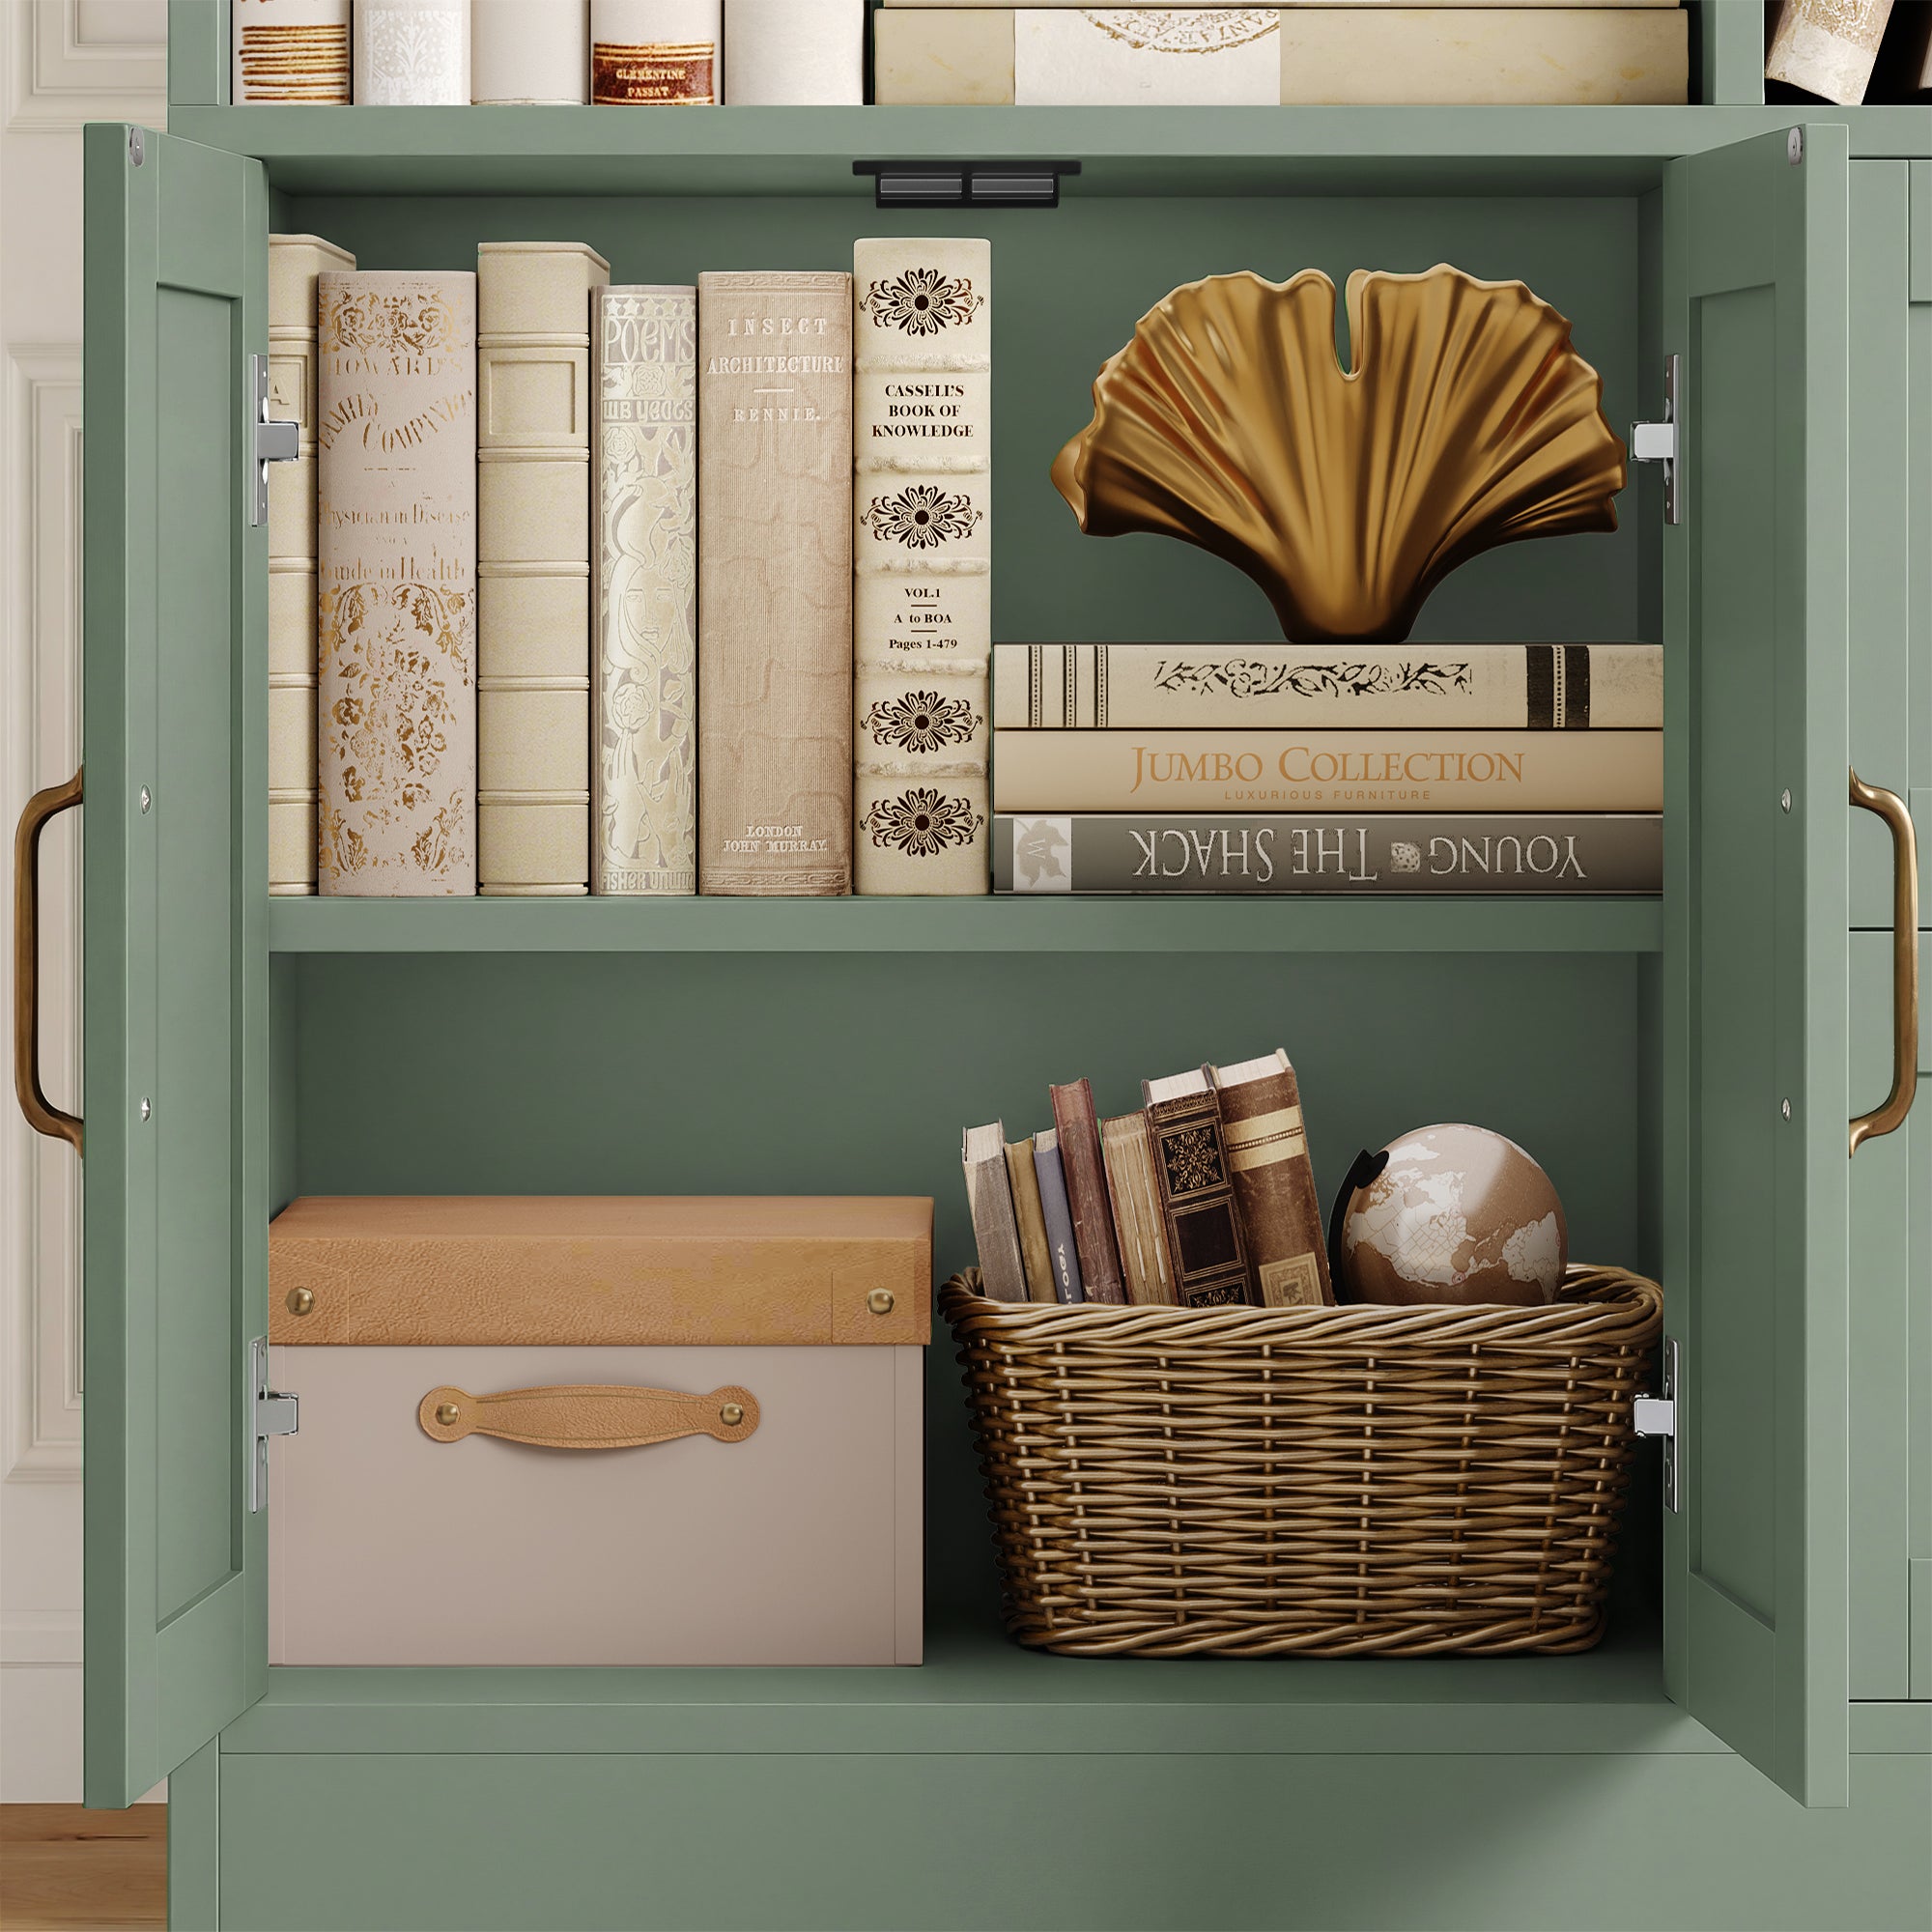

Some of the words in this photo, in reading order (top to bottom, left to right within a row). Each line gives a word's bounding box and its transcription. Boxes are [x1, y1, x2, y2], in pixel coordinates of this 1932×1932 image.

[627, 85, 669, 98] PASSAT
[727, 318, 827, 336] INSECT
[604, 317, 696, 364] POEMS
[706, 355, 844, 375] ARCHITECTURE
[885, 384, 964, 397] CASSELL'S
[733, 407, 821, 422] RENNIE.
[889, 405, 935, 417] BOOK
[939, 405, 961, 417] OF
[871, 424, 974, 438] KNOWLEDGE
[904, 587, 941, 599] VOL.1
[894, 613, 903, 624] A
[909, 613, 921, 624] to
[923, 613, 952, 624] BOA
[889, 639, 923, 652] Pages
[925, 639, 958, 650] 1-479
[1130, 747, 1264, 794] JUMBO
[1278, 746, 1525, 783] COLLECTION
[1224, 790, 1323, 801] LUXURIOUS
[1333, 790, 1431, 801] FURNITURE
[745, 824, 804, 838] LONDON
[723, 838, 761, 853] JOHN
[1128, 828, 1276, 883] SHACK
[1291, 827, 1378, 882] THE
[1427, 835, 1588, 880] YOUNG
[1058, 1243, 1072, 1305] LOGY
